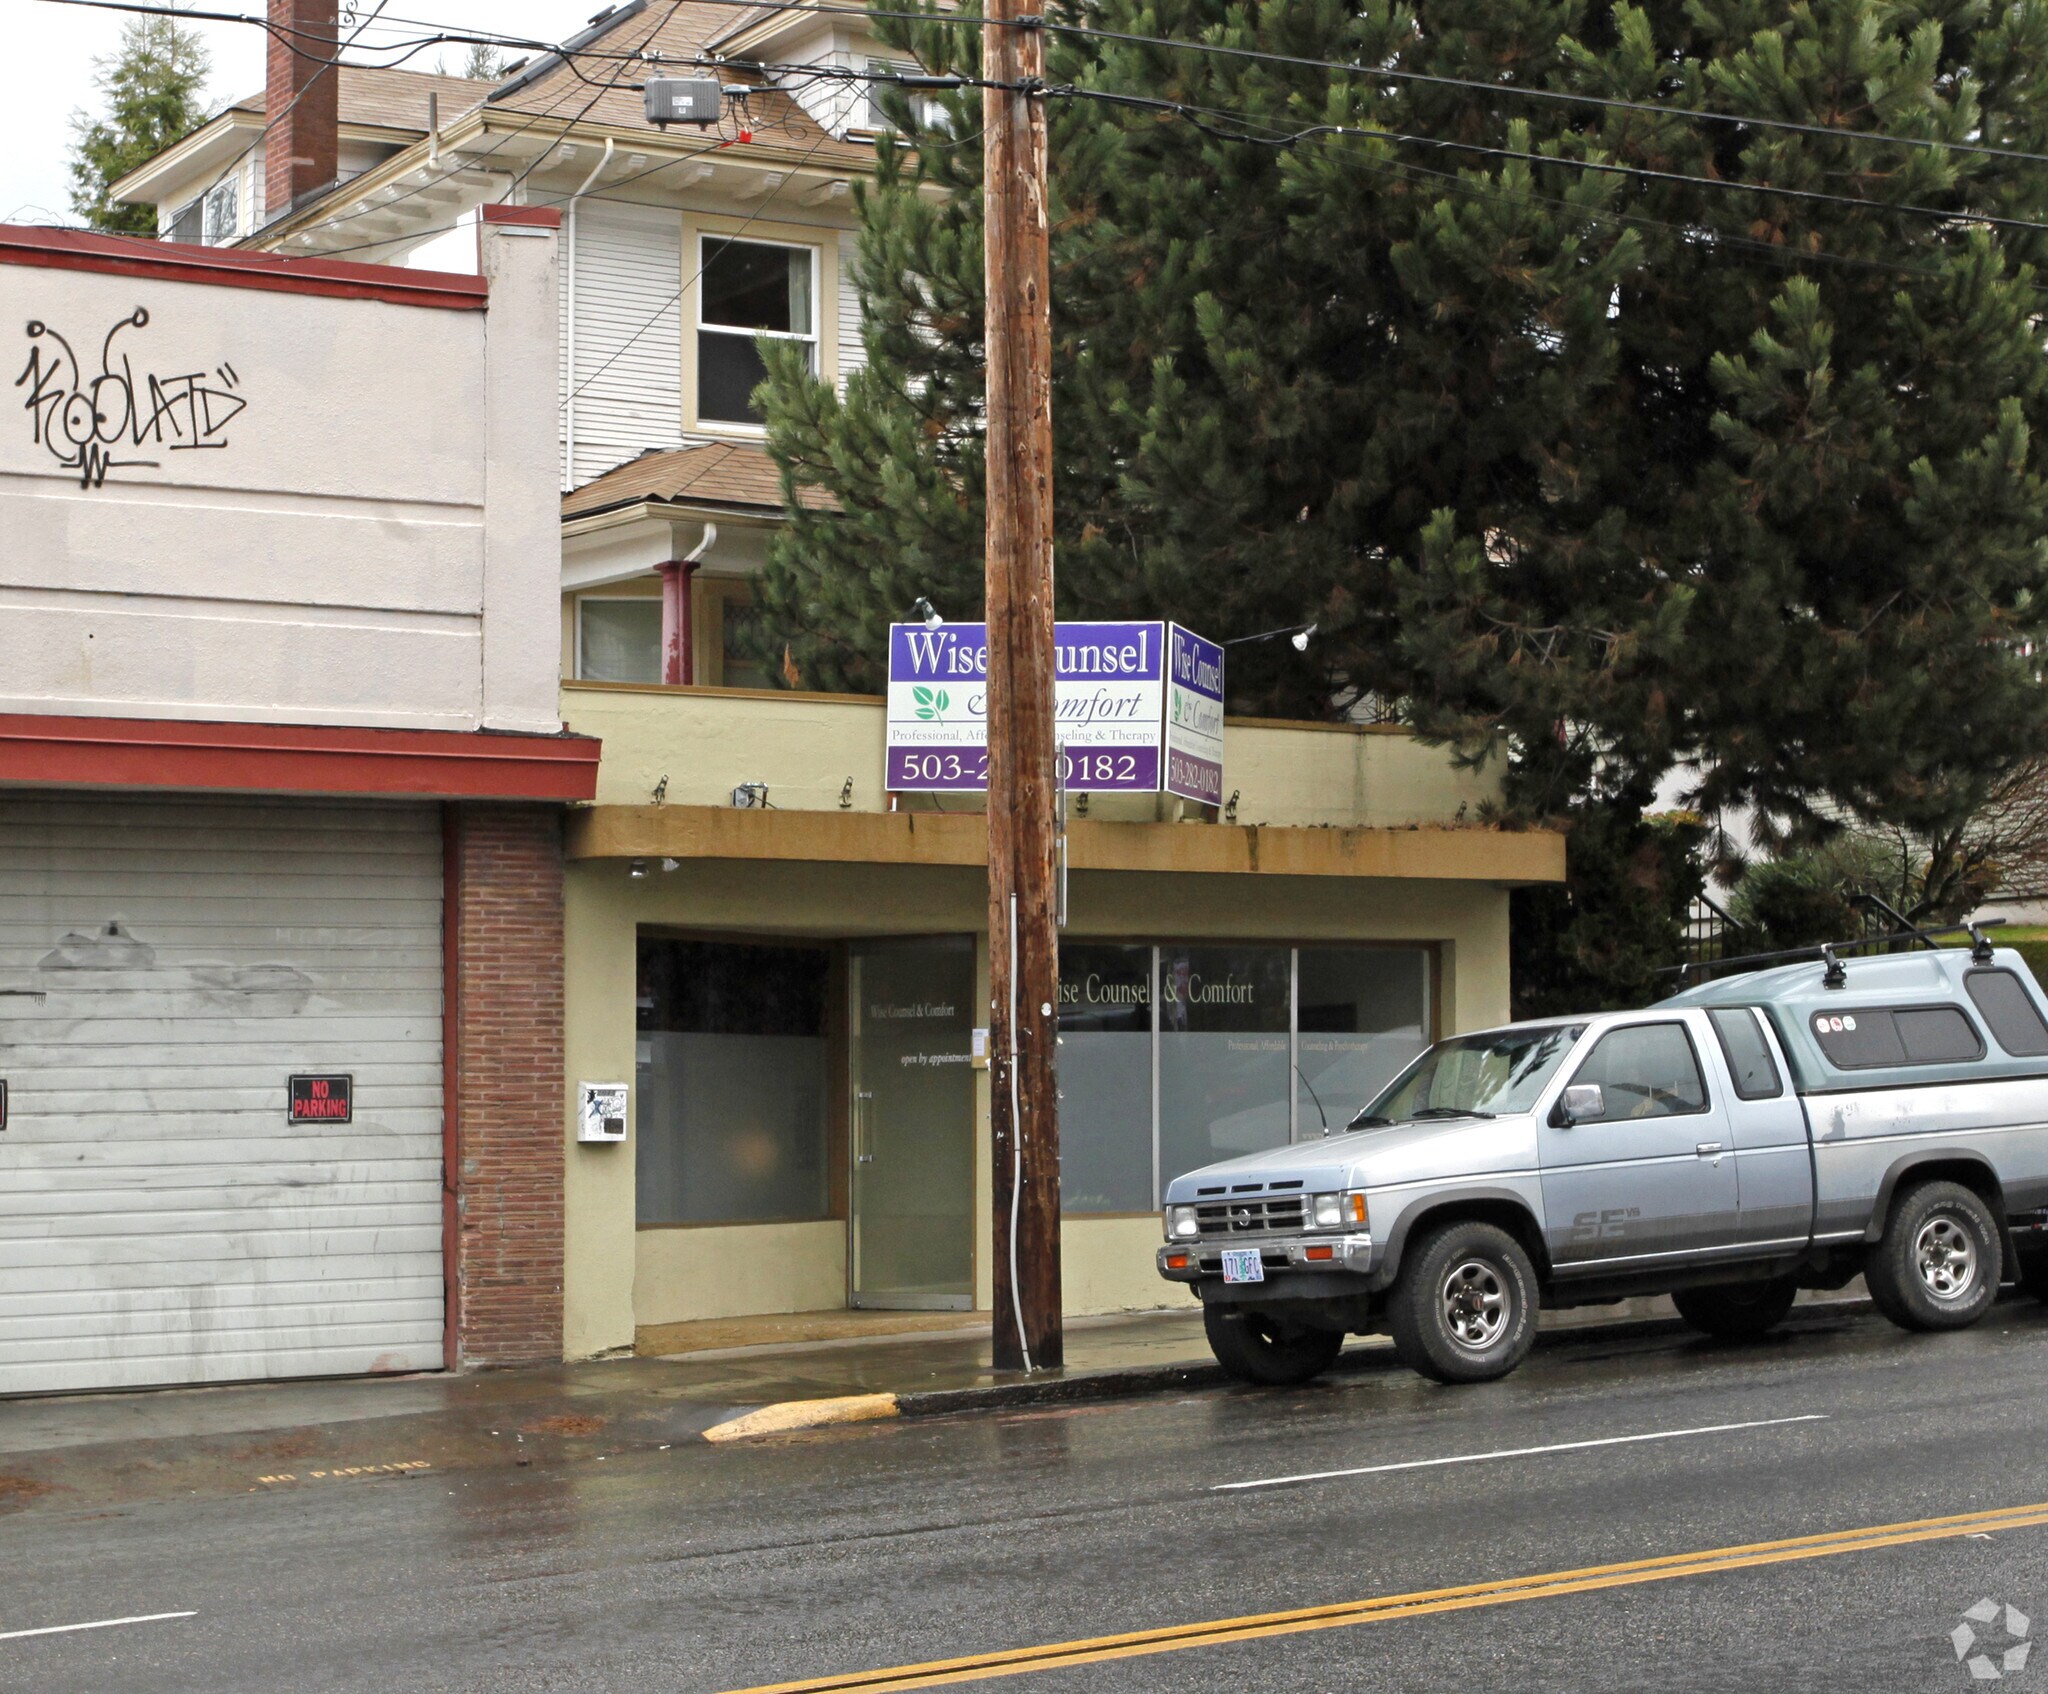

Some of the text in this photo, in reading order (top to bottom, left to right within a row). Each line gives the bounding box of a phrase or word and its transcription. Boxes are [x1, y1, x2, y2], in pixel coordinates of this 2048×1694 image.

[905, 630, 1149, 674] Wise unsel
[1055, 688, 1142, 728] mfort
[892, 729, 962, 742] Professional,
[1095, 732, 1106, 741] &
[1109, 730, 1156, 744] Therapy
[1058, 973, 1254, 1004] ise Counsel & Comfort
[888, 1003, 915, 1018] Counsel
[916, 1004, 924, 1017] &
[924, 1001, 955, 1017] Comfort
[901, 1052, 972, 1067] open by appointment
[312, 1080, 330, 1099] NO
[294, 1099, 347, 1117] PARKING
[1570, 1209, 1625, 1241] SE
[258, 1473, 297, 1483] NO
